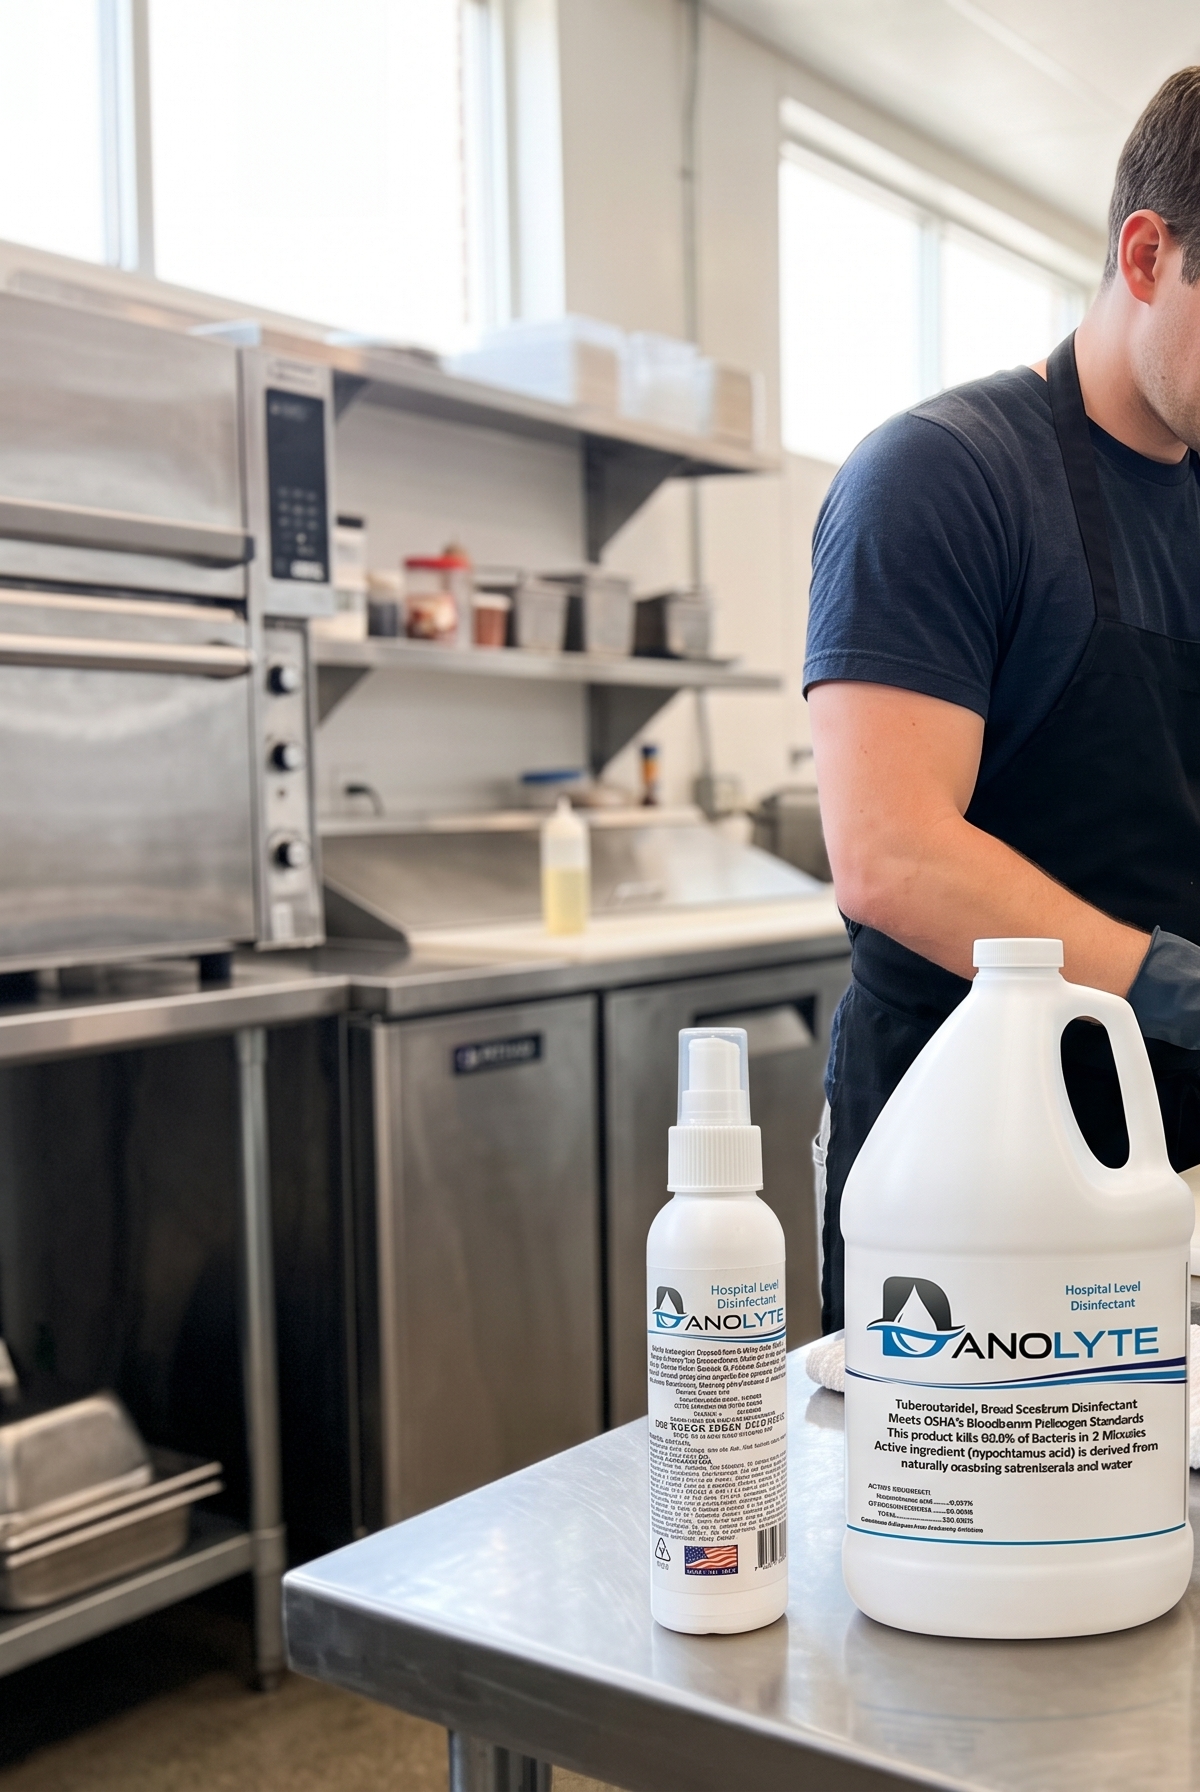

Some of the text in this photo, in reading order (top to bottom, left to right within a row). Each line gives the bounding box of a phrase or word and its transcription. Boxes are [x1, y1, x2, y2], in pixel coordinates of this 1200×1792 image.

[711, 1279, 779, 1296] Hospital Level
[1065, 1281, 1141, 1298] Hospital Level
[717, 1294, 777, 1310] Disinfectant
[1070, 1298, 1136, 1311] Disinfectant
[1071, 1399, 1138, 1413] Disinfectant
[888, 1413, 921, 1426] Meets
[924, 1416, 964, 1428] OSHA's
[887, 1427, 909, 1439] This
[911, 1431, 953, 1442] product
[1017, 1432, 1030, 1443] of
[1032, 1433, 1076, 1443] Bacteris
[1079, 1432, 1089, 1442] in
[1092, 1431, 1099, 1441] 2
[874, 1441, 908, 1453] Active
[910, 1444, 965, 1457] ingredient
[1048, 1447, 1076, 1459] acid)
[1078, 1447, 1087, 1457] is
[1090, 1443, 1130, 1456] derived
[1132, 1442, 1159, 1453] from
[901, 1460, 949, 1473] naturally
[1077, 1461, 1099, 1471] and
[1101, 1460, 1133, 1470] water
